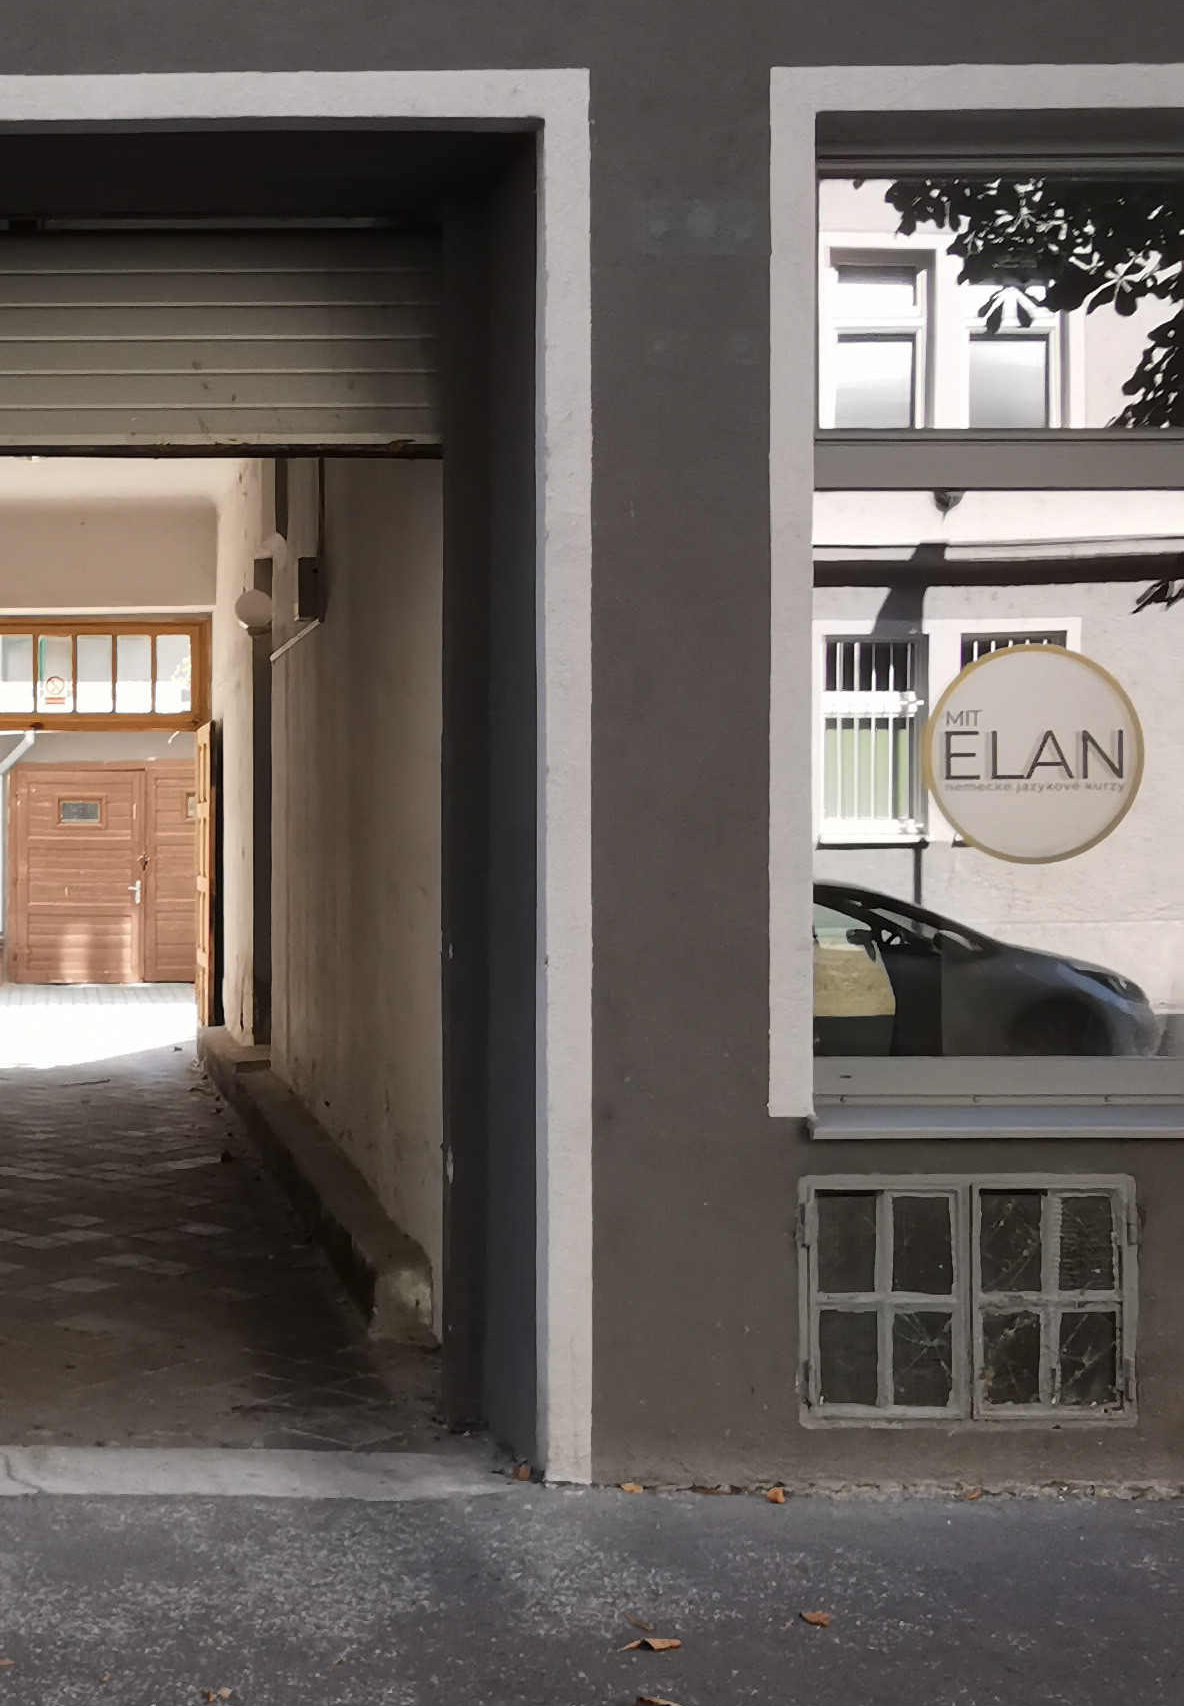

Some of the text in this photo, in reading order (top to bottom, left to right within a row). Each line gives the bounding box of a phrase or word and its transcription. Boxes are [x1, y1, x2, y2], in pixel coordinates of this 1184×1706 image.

[945, 709, 982, 727] MIT
[944, 729, 1124, 780] ELAN
[1085, 780, 1126, 793] kurzy
